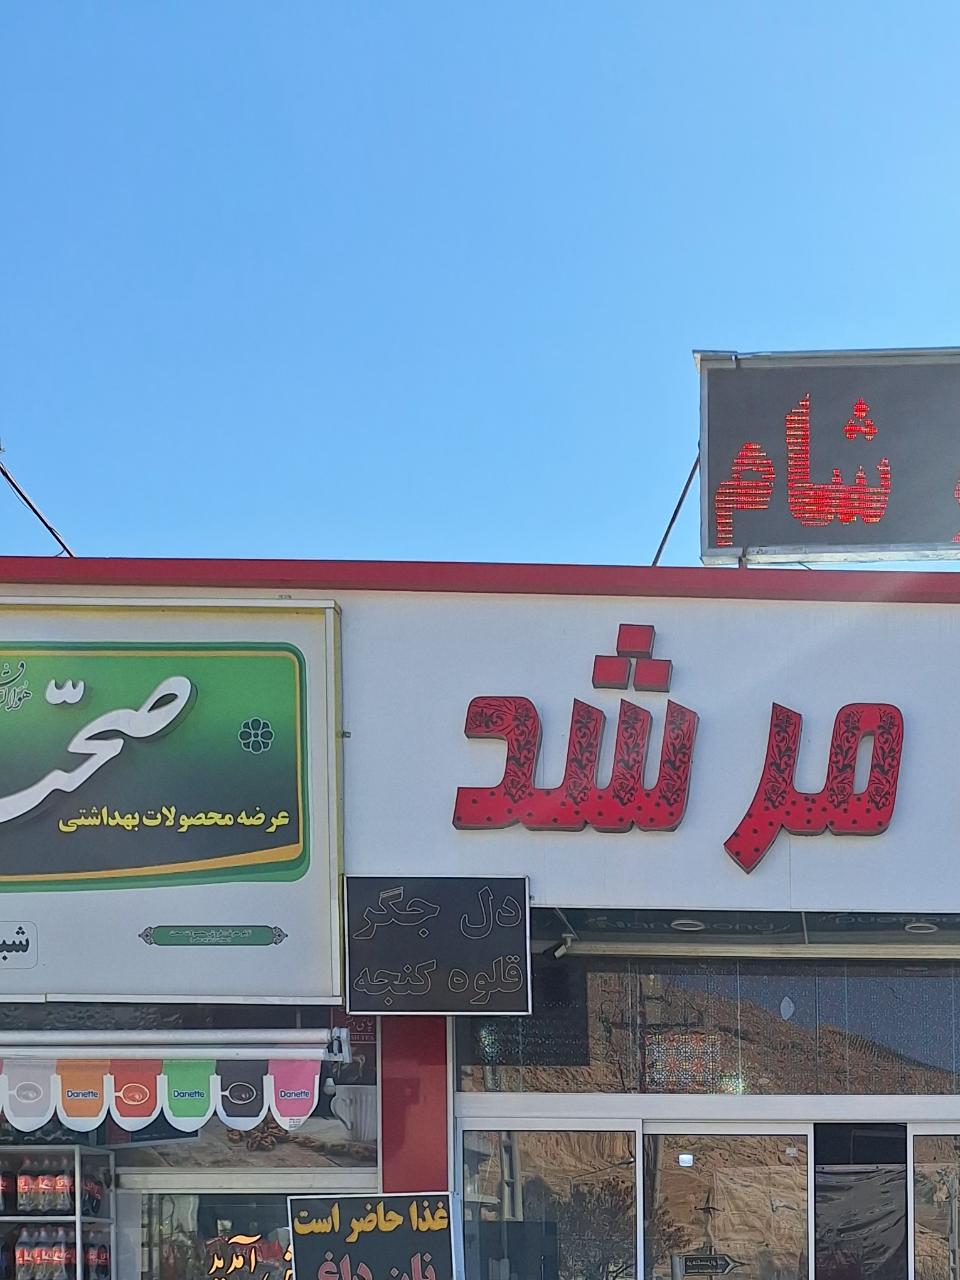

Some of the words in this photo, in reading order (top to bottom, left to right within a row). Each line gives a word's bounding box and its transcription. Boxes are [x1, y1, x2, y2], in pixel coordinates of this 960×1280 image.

[714, 392, 892, 548] شام
[453, 623, 904, 875] مرشد
[58, 805, 140, 833] بهداشتی
[142, 805, 234, 833] محصولات
[236, 805, 290, 833] عرضه
[352, 886, 441, 940] جگر
[460, 886, 522, 940] دل
[353, 959, 437, 1006] کنجه
[448, 955, 524, 1005] قلوه
[66, 1088, 99, 1099] Danette
[172, 1088, 206, 1099] Danette
[279, 1088, 311, 1099] Danette
[293, 1202, 340, 1235] است
[345, 1200, 404, 1243] حاضر
[408, 1199, 449, 1232] غذا
